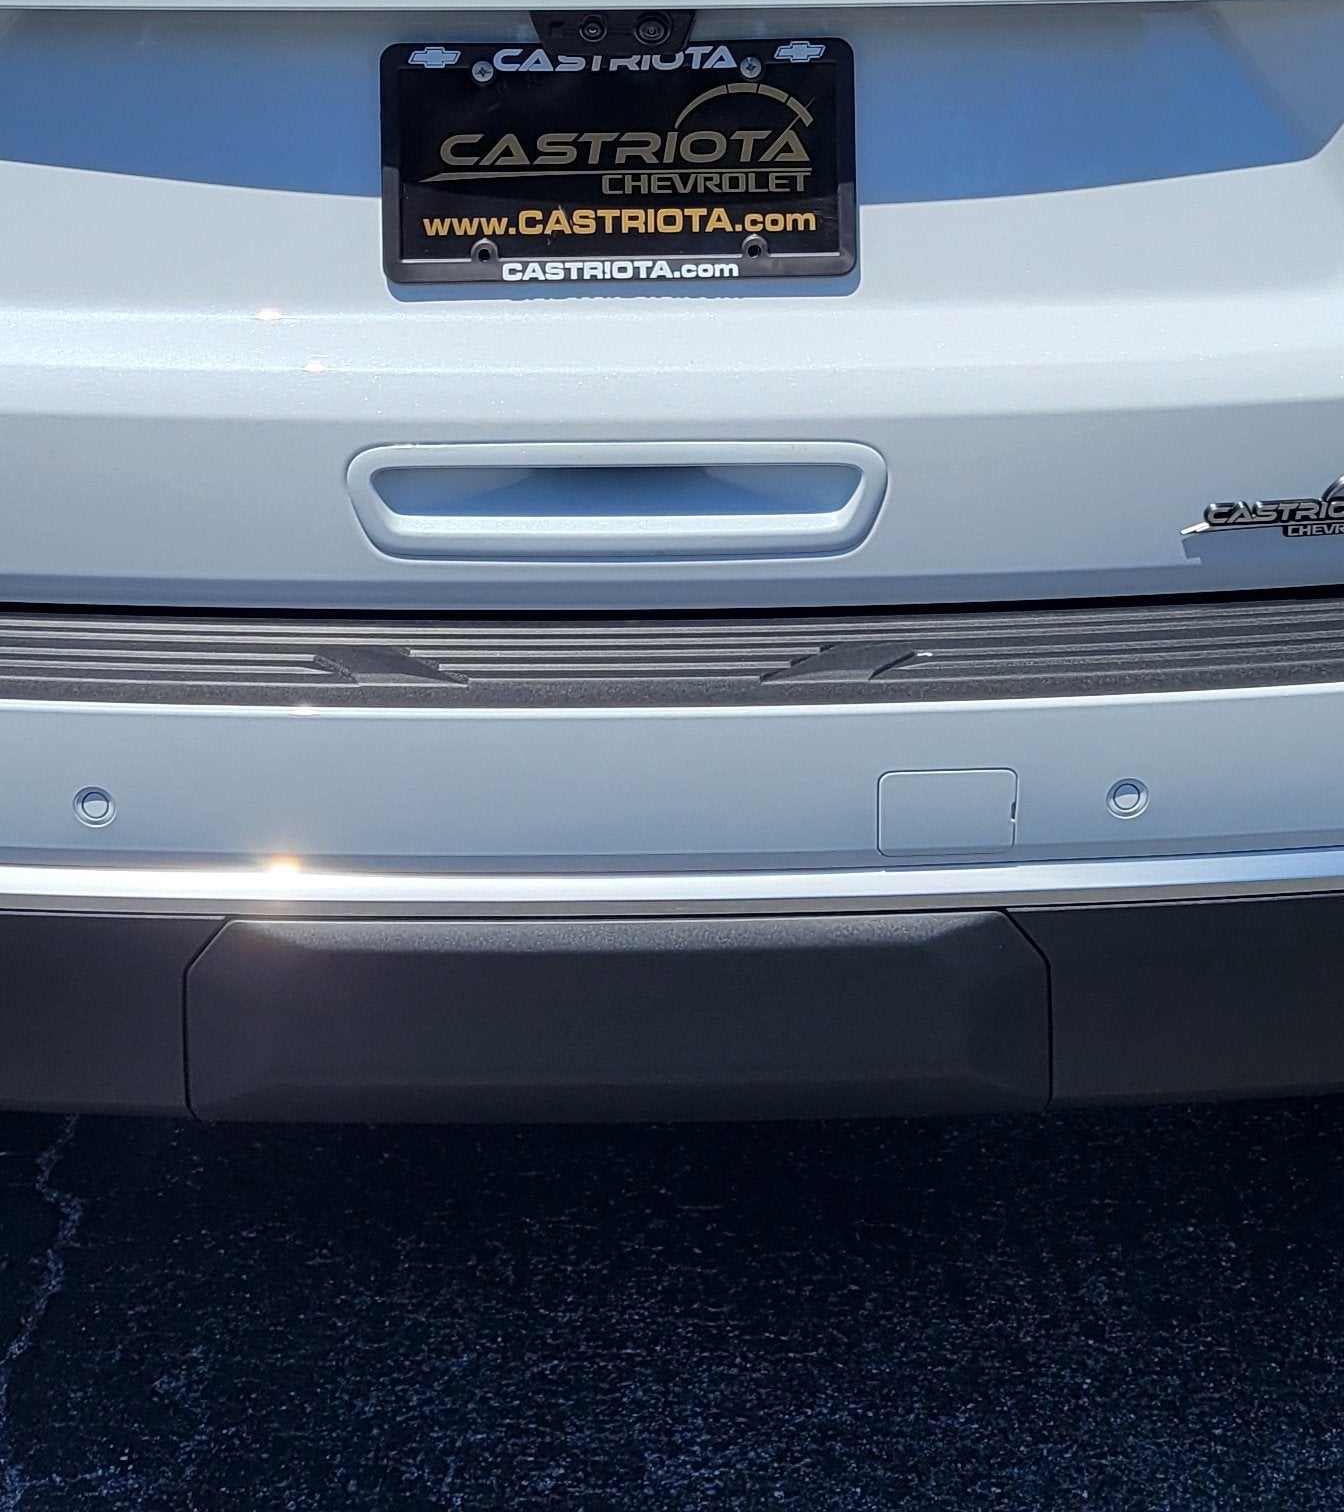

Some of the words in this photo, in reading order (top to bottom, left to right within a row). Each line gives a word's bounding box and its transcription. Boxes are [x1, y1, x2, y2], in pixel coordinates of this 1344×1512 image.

[439, 129, 812, 166] CASTRIOTA
[601, 172, 811, 195] CHEVROLET
[422, 207, 817, 237] www.CASTRIOTA.com
[502, 260, 739, 282] CASTRIOTA.com
